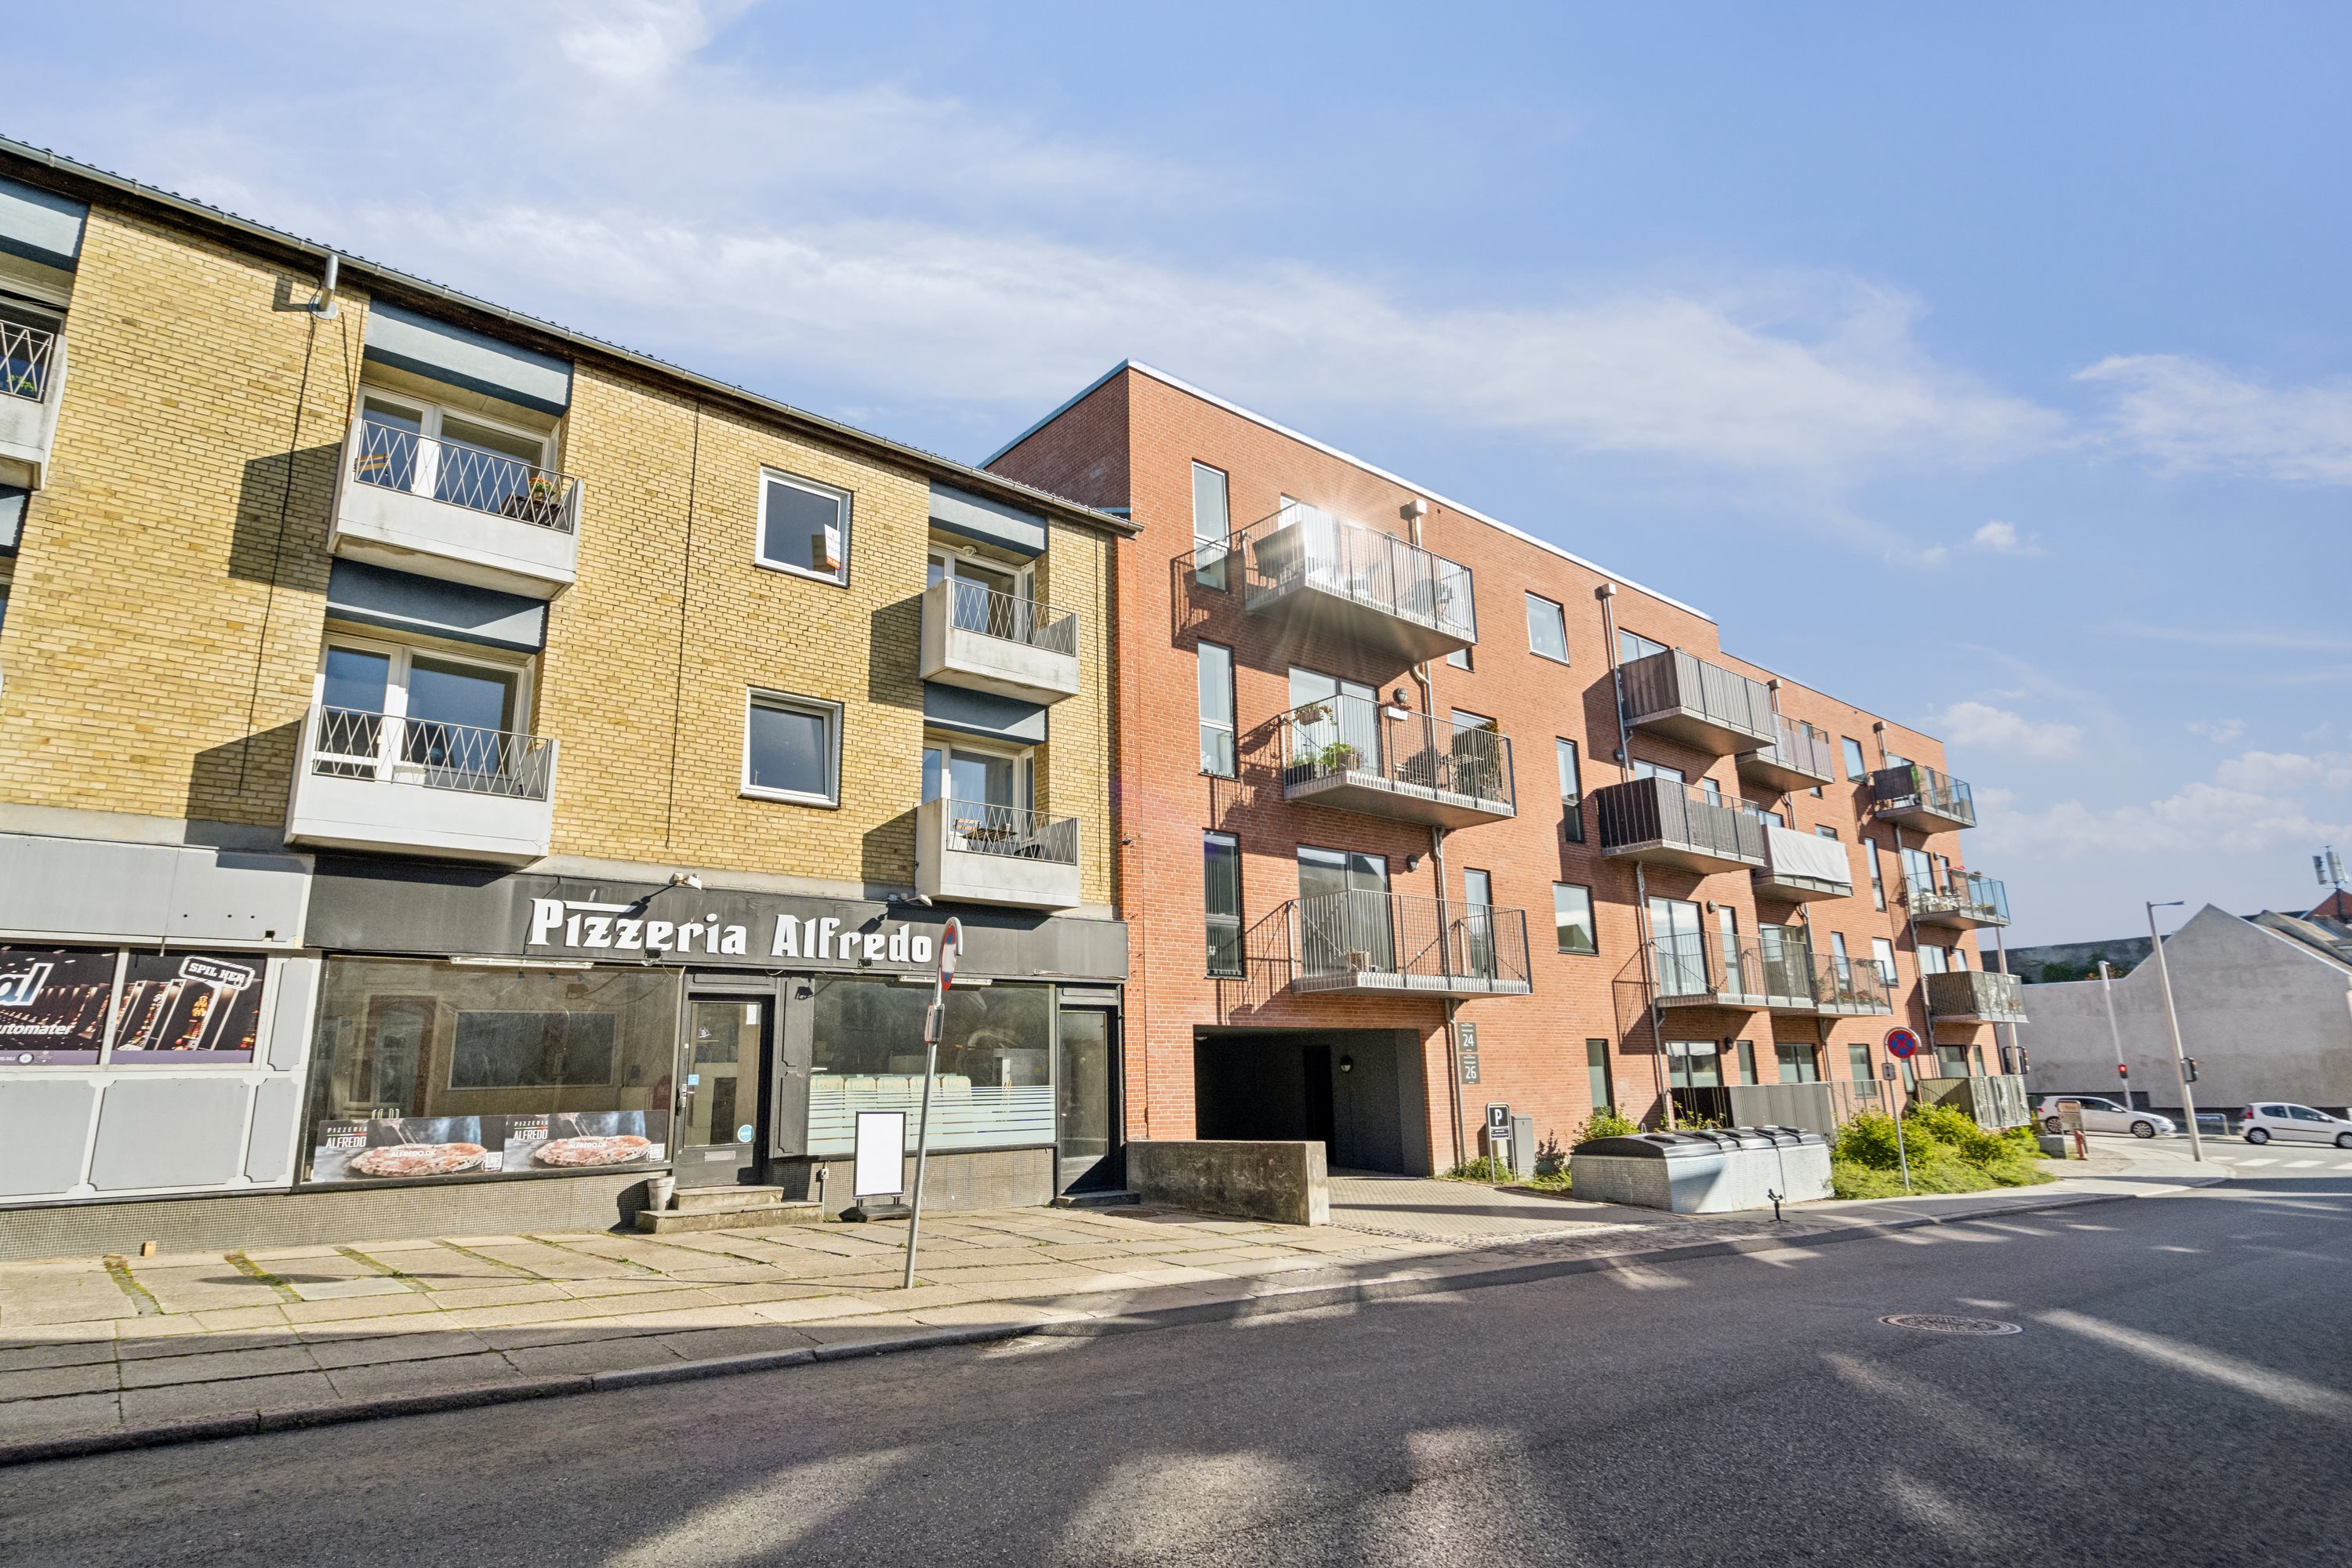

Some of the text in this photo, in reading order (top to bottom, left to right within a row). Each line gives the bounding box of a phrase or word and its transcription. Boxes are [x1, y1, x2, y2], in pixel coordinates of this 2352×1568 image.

[528, 898, 932, 963] Pizzeria Alfredo
[188, 962, 245, 985] SPIL HER
[1463, 1034, 1474, 1047] 24
[1465, 1065, 1476, 1079] 26
[1494, 1109, 1503, 1126] P
[514, 1129, 548, 1141] ALFREDO
[325, 1136, 367, 1149] ALFREDO
